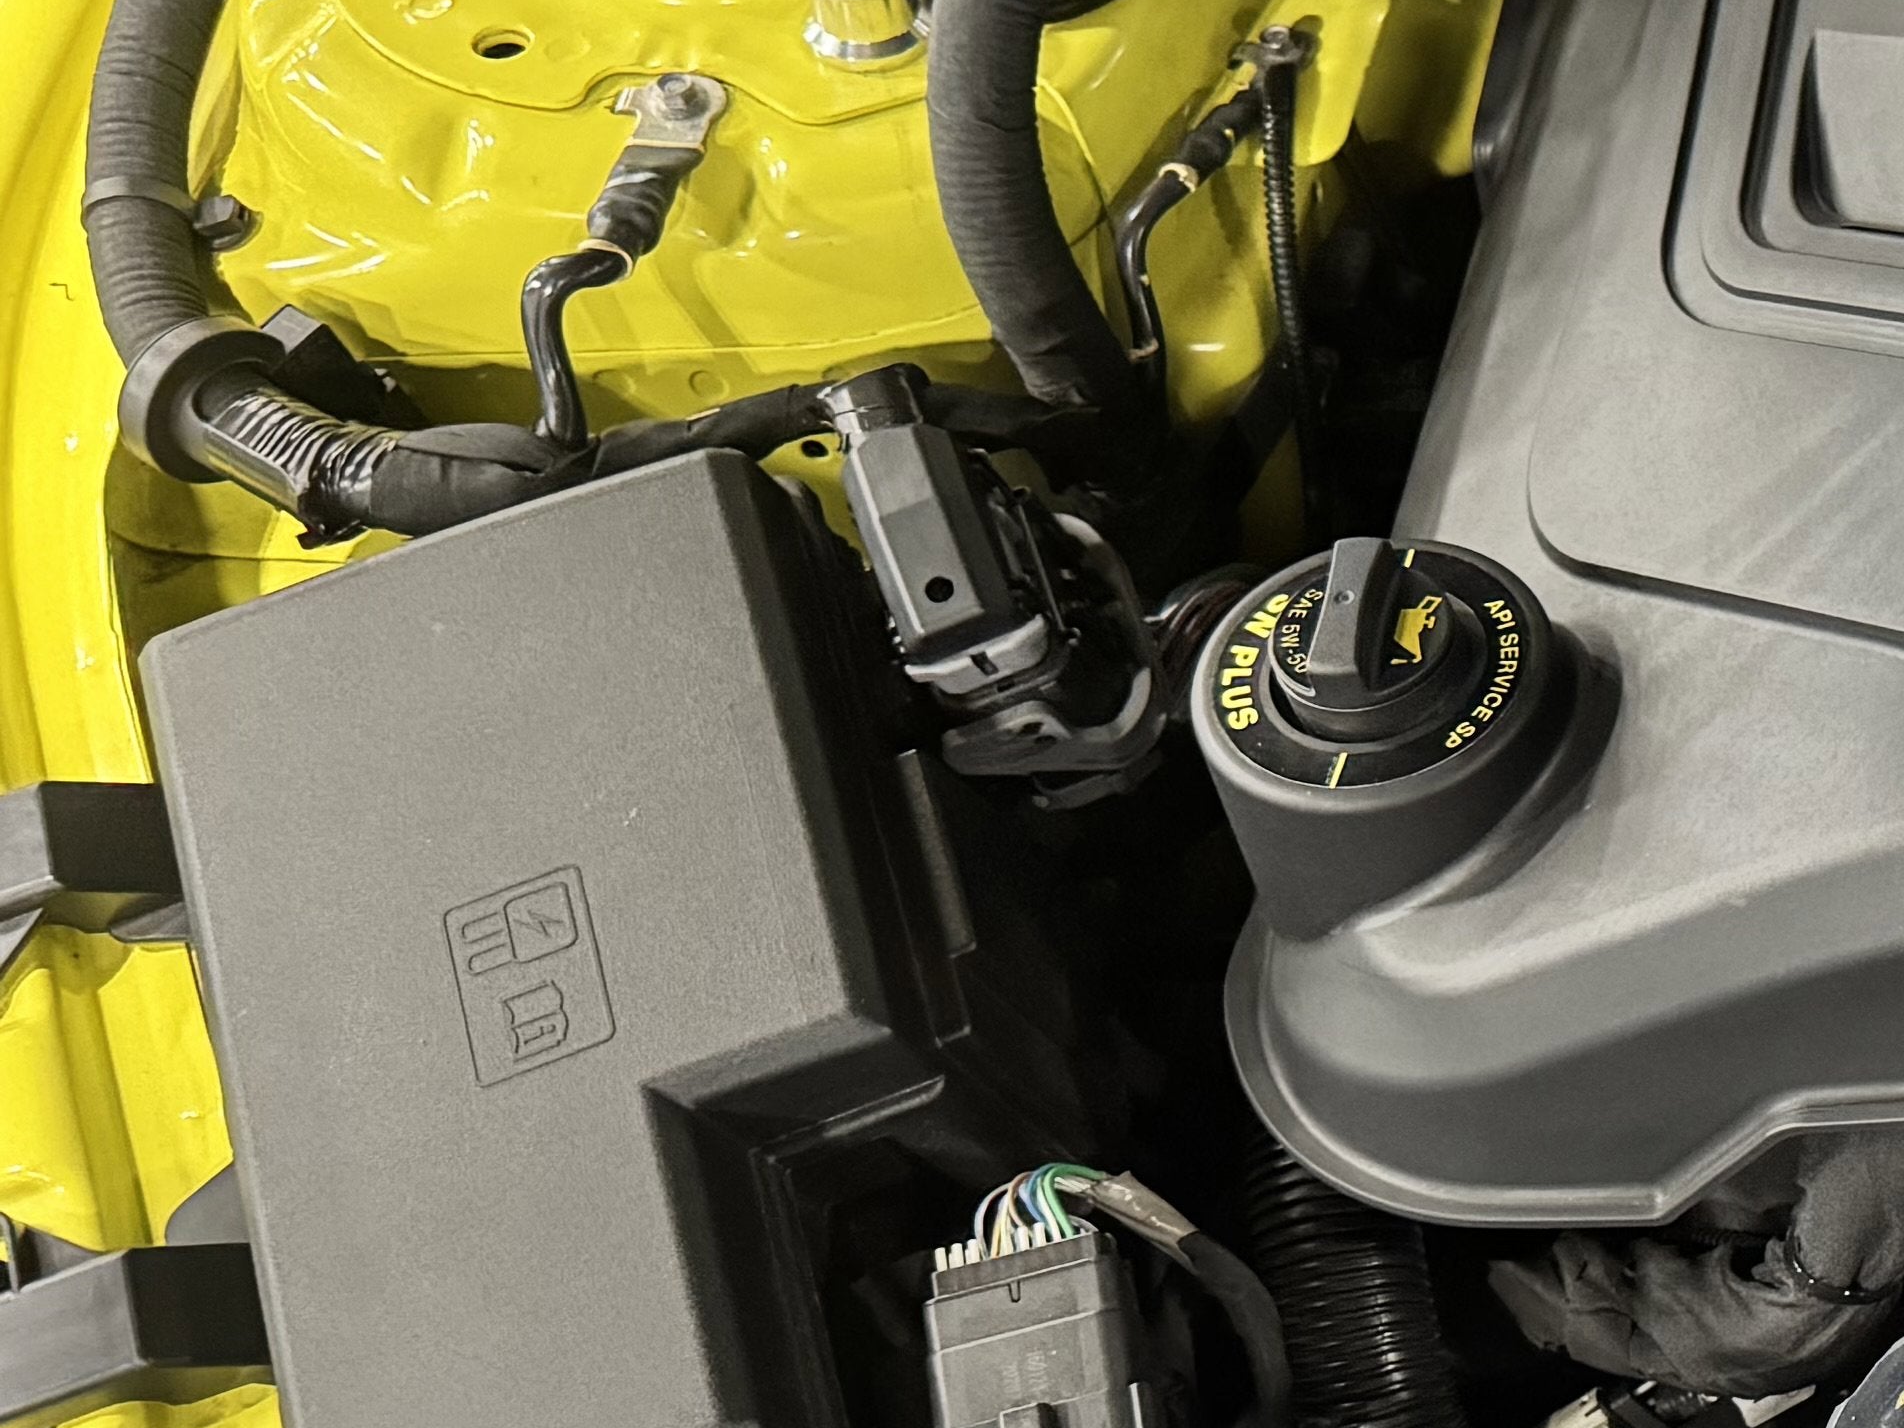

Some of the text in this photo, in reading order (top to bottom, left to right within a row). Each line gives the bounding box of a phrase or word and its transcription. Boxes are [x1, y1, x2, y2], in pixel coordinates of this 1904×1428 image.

[1281, 588, 1324, 674] SAE 5W-50
[1444, 598, 1521, 750] API SERVICE SP
[1221, 644, 1260, 731] PLUS
